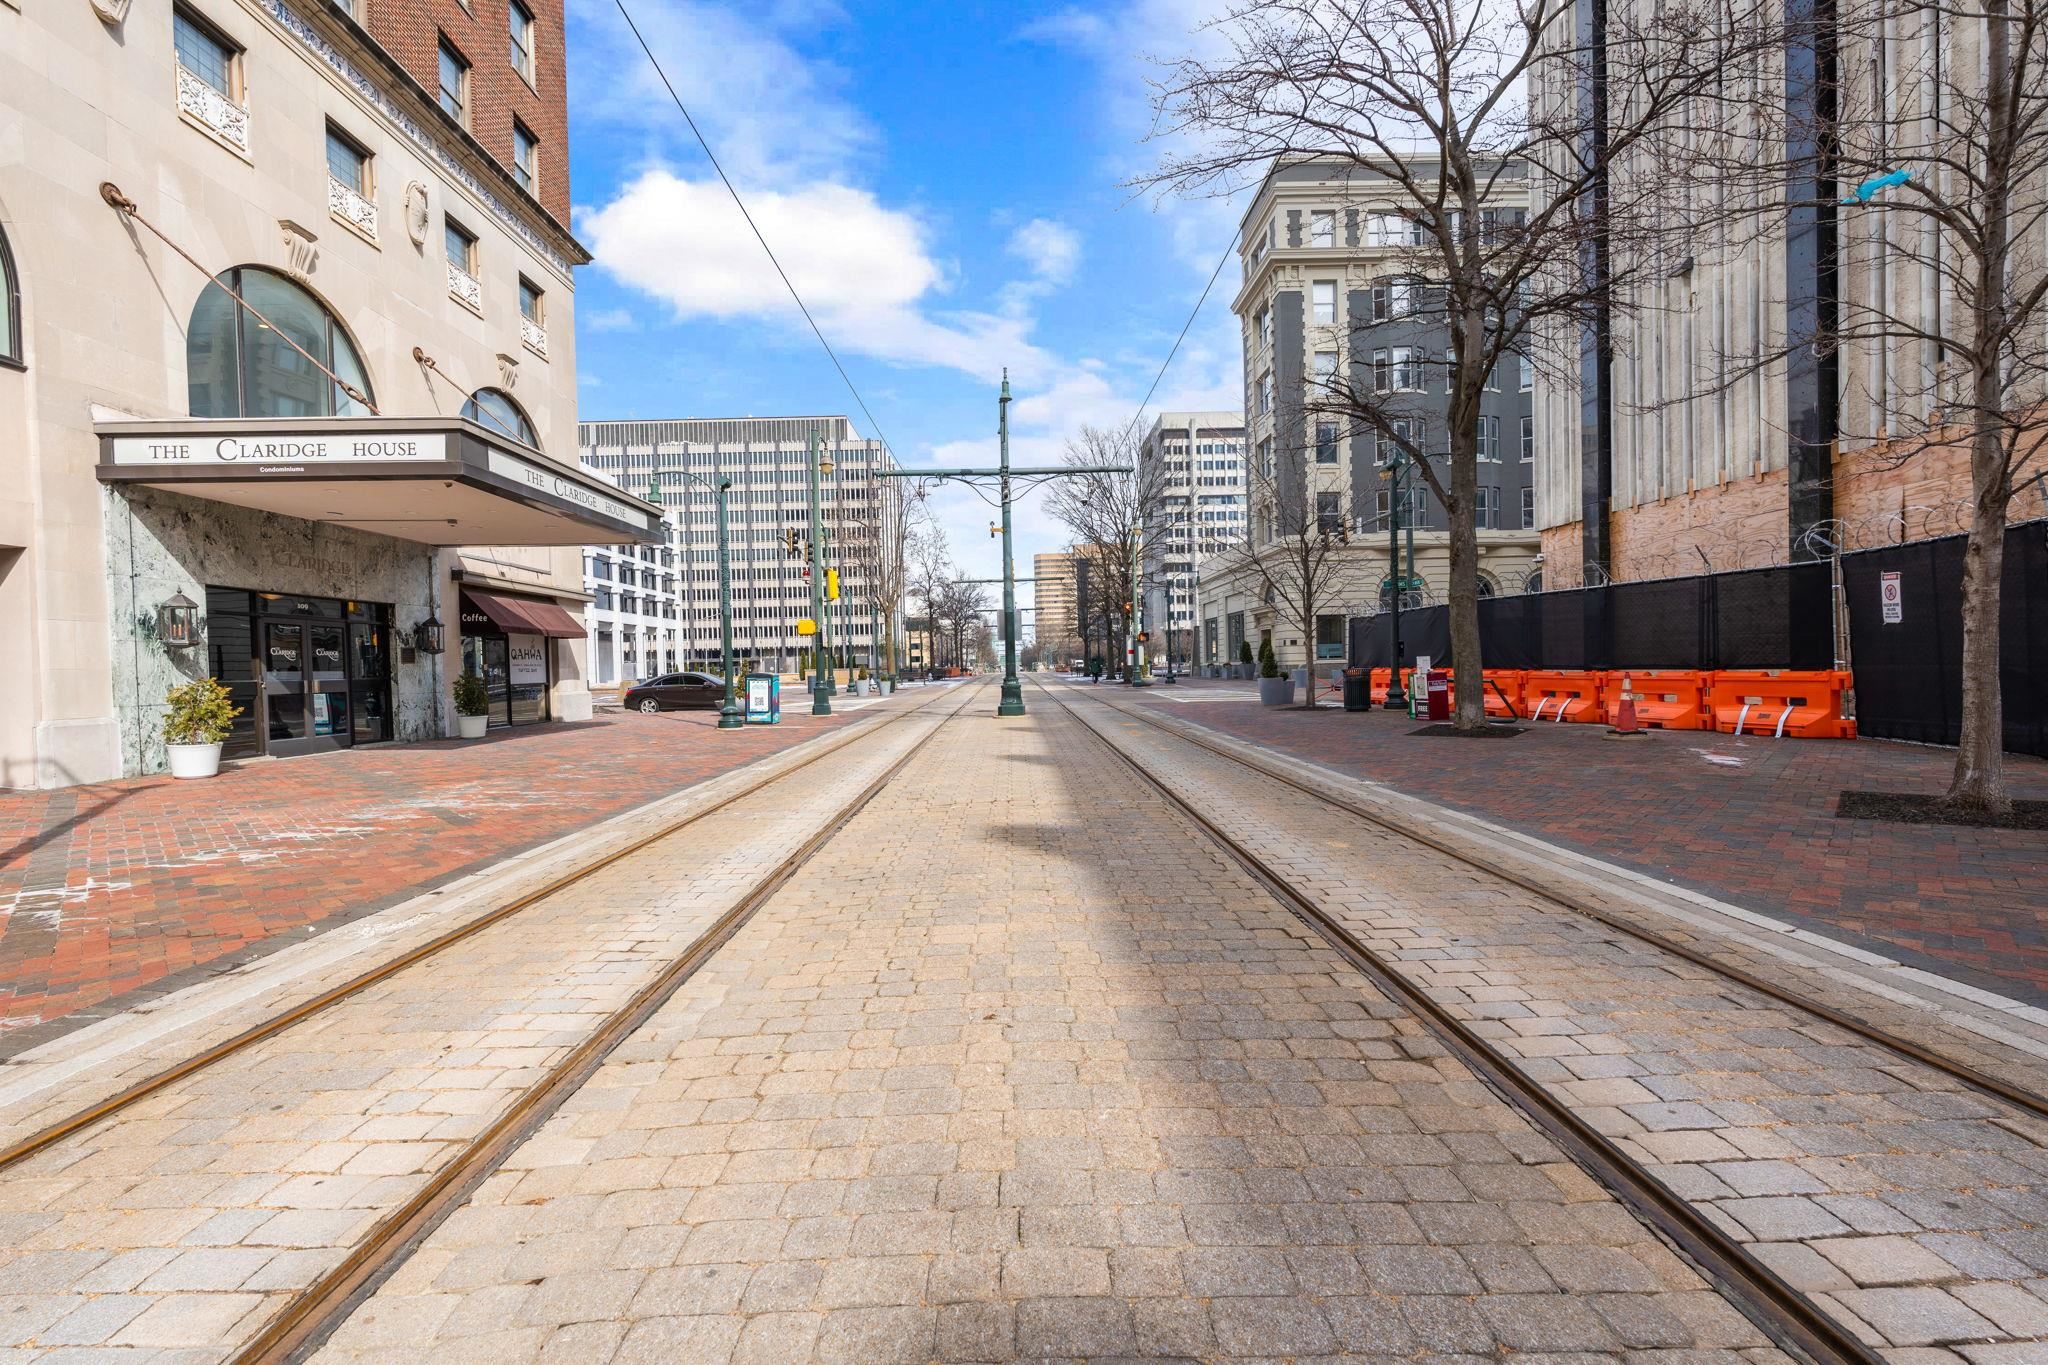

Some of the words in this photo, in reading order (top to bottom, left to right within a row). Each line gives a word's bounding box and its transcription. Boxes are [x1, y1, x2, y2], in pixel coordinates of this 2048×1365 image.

[149, 445, 190, 460] THE
[216, 438, 327, 461] CLARIDGE
[352, 441, 417, 457] HOUSE
[525, 469, 545, 488] THE
[554, 477, 597, 508] CLARIDGE
[605, 501, 627, 519] HOUSE
[462, 613, 488, 621] Coffee
[511, 648, 542, 660] QAHWA
